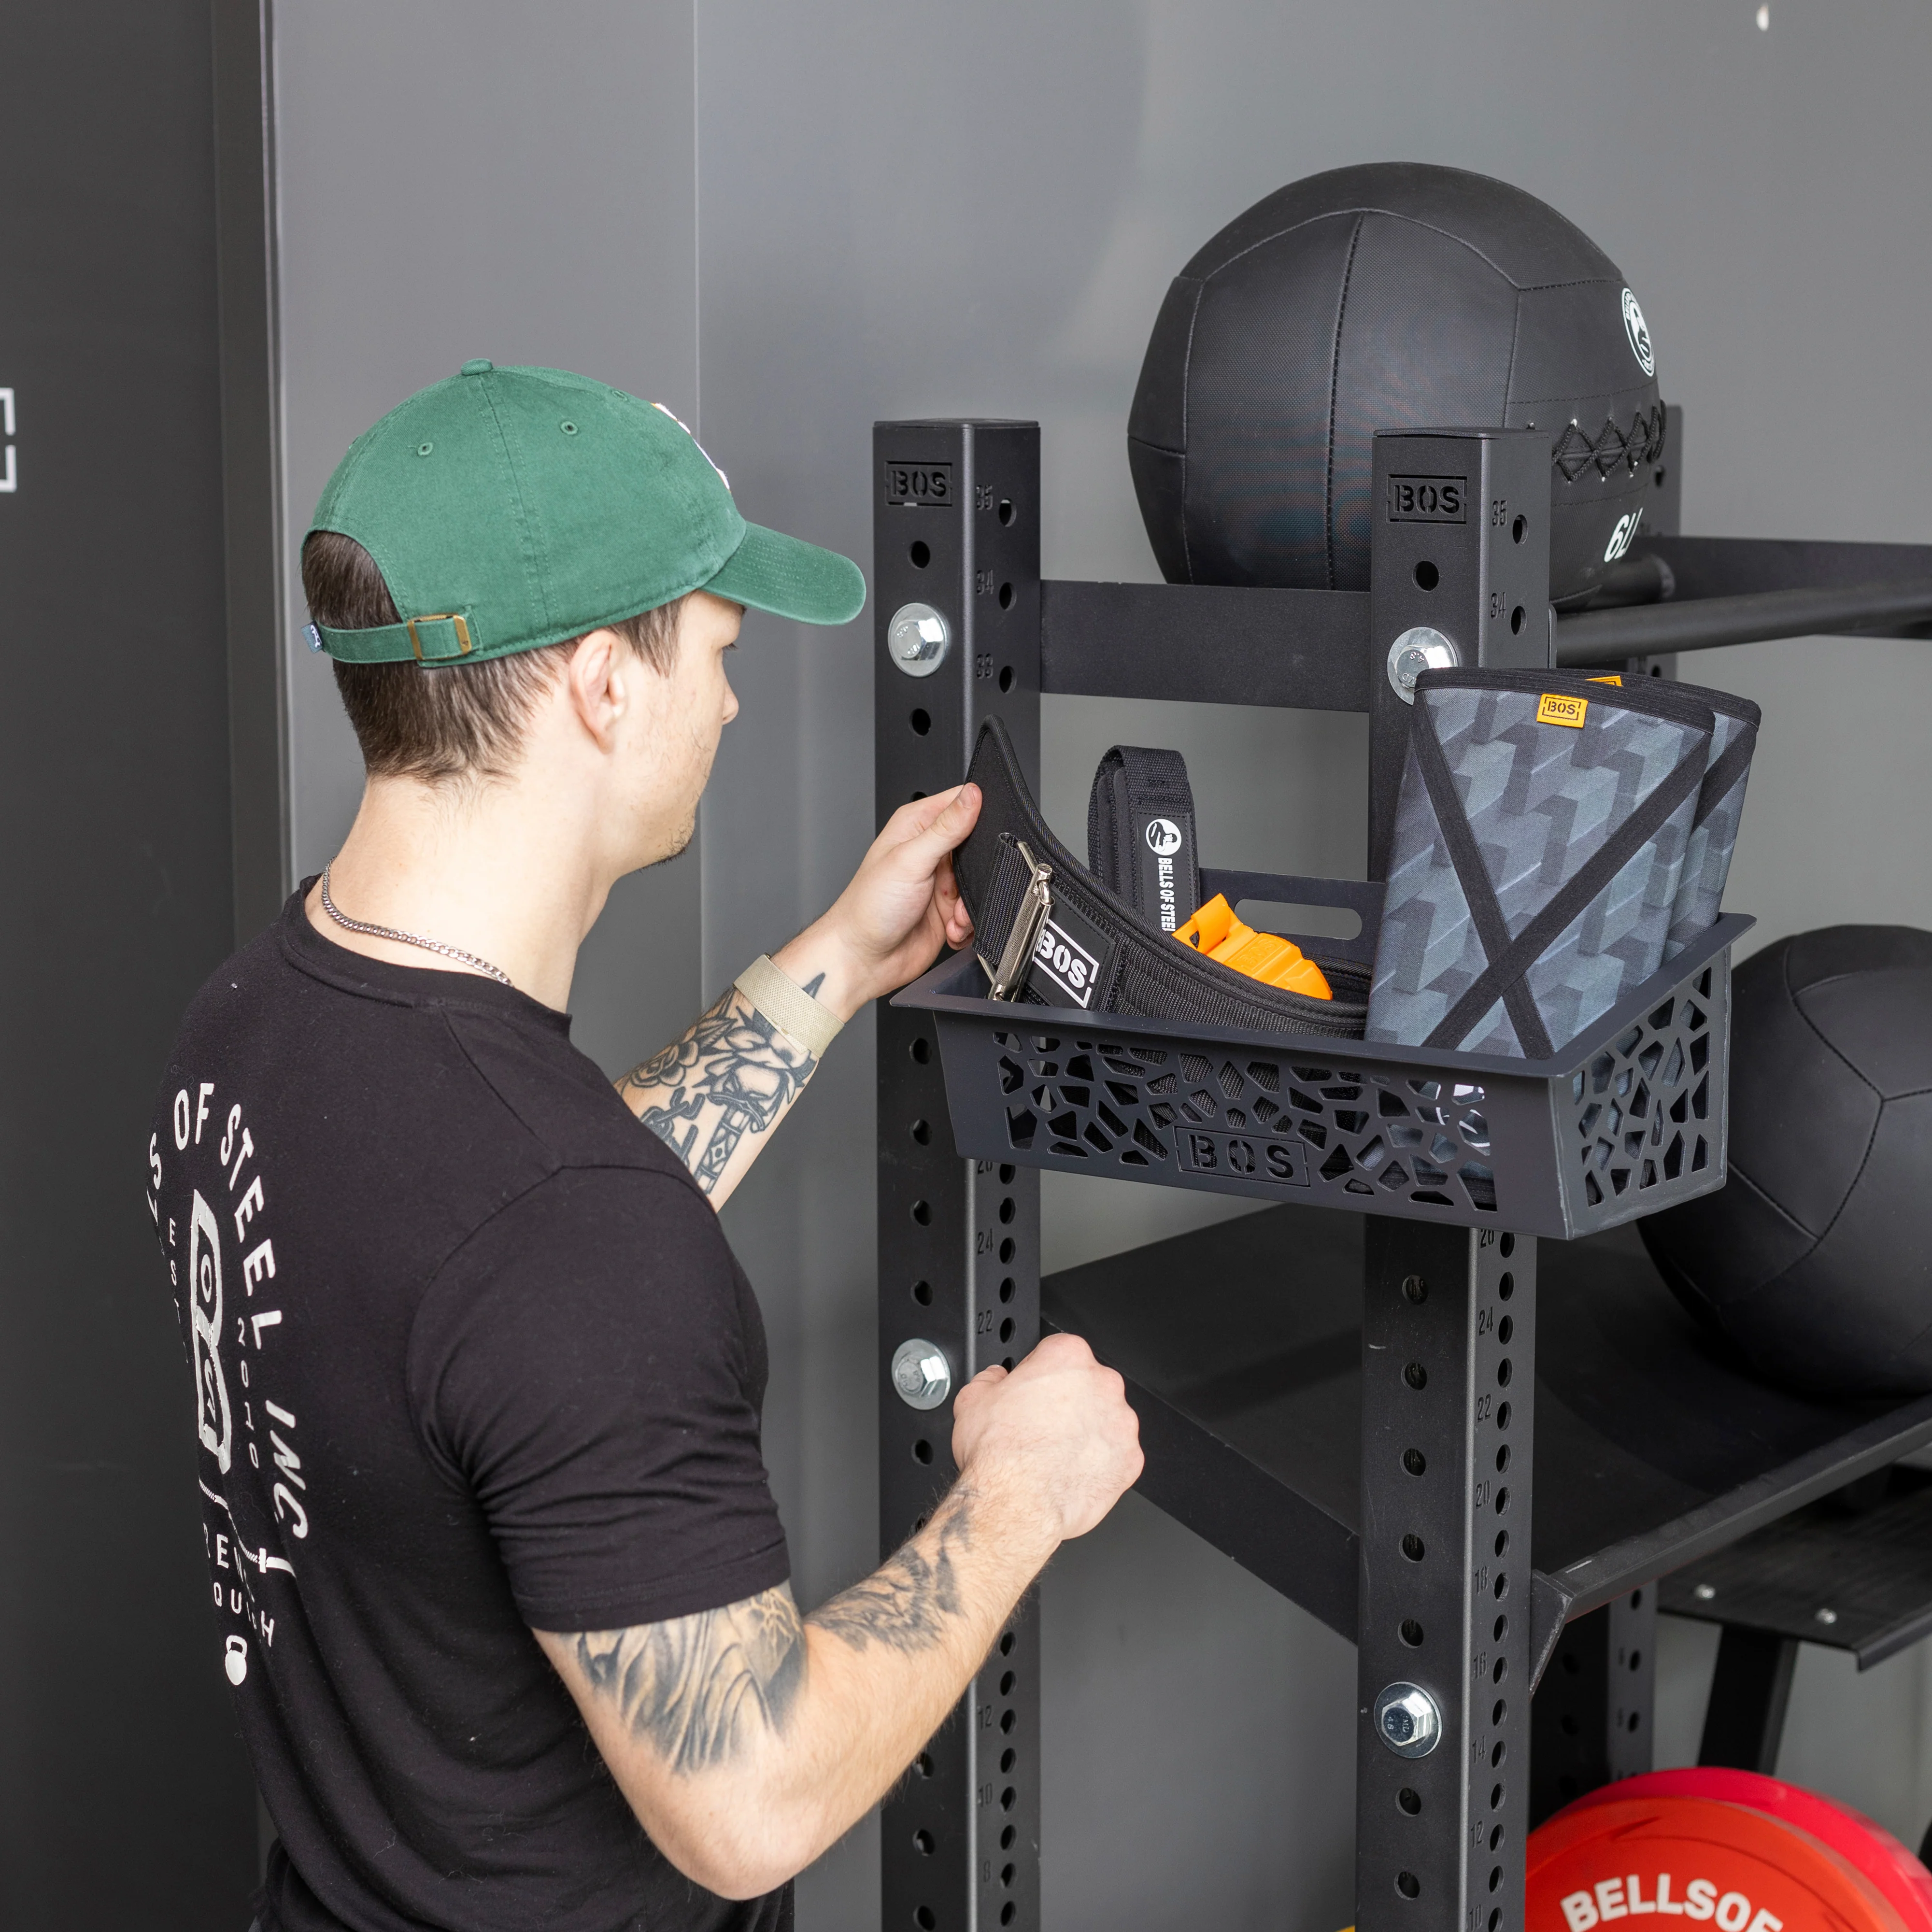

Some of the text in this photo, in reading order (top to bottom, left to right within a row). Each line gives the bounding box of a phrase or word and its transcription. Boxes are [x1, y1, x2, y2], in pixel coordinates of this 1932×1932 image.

[891, 470, 947, 498] BOS
[1393, 484, 1460, 514] BOS
[1492, 500, 1507, 527] 35
[976, 569, 994, 595] 34
[1491, 592, 1507, 619] 34
[1548, 701, 1576, 715] BOS
[1158, 857, 1174, 888] BELLS
[1160, 889, 1175, 903] OF
[1037, 929, 1087, 988] BOS
[1188, 1134, 1294, 1179] BOS
[174, 1082, 215, 1151] OF
[220, 1104, 283, 1350] STEEL
[978, 1228, 994, 1254] 24
[978, 1309, 993, 1335] 22
[1479, 1306, 1494, 1336] 24
[1477, 1394, 1492, 1423] 22
[1476, 1480, 1492, 1509] 20
[1472, 1736, 1487, 1764] 14
[1470, 1820, 1484, 1849] 12
